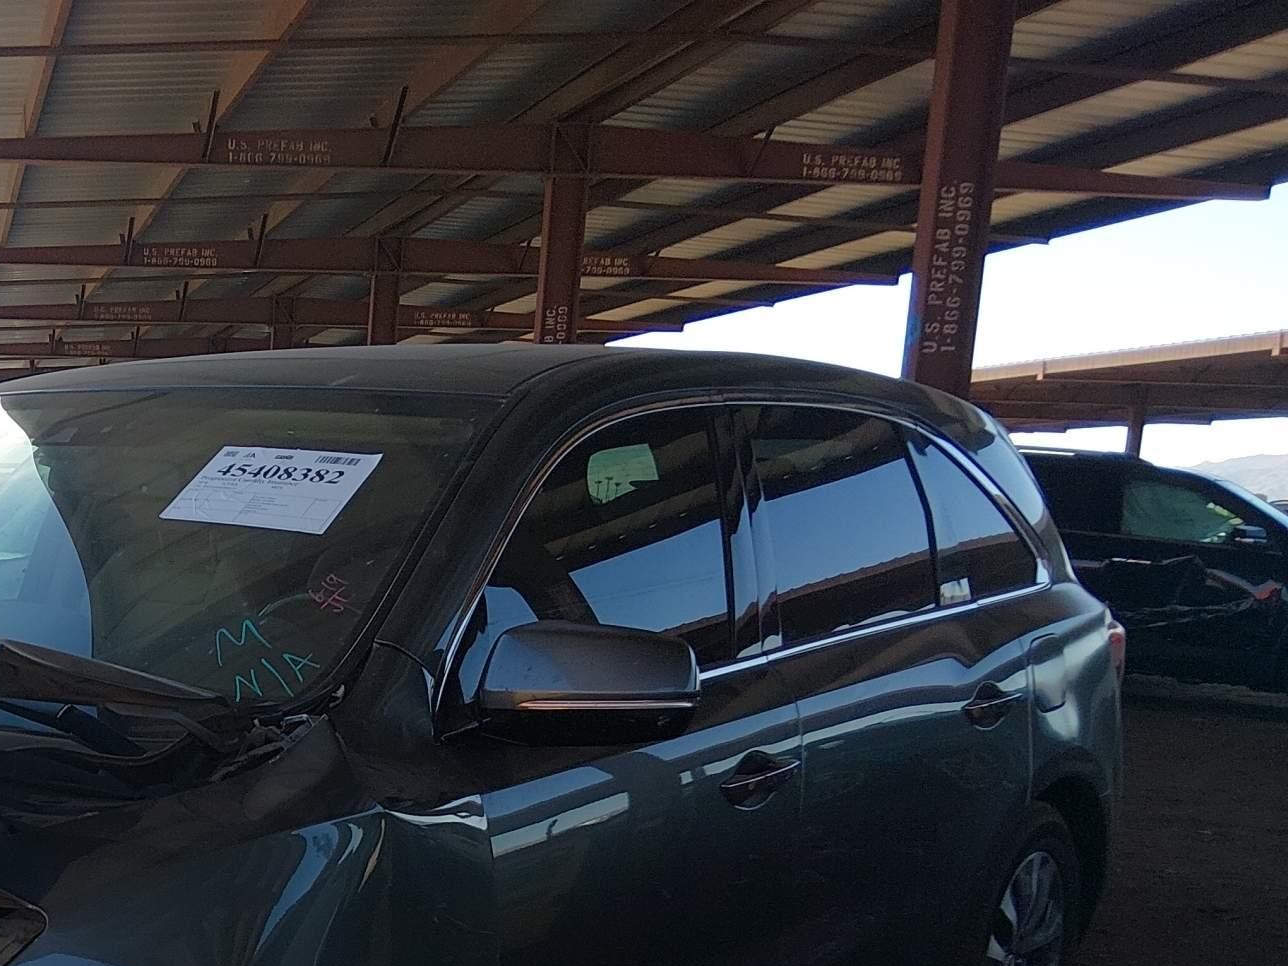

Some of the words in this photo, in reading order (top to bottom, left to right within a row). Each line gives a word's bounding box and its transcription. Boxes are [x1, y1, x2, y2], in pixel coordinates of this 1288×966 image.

[257, 139, 304, 152] PREFAB
[831, 154, 877, 169] PREFAB
[164, 247, 198, 257] PREFAB
[927, 227, 952, 306] PREFAB
[939, 181, 976, 353] 1-866-799-0969
[216, 462, 346, 485] 45408382
